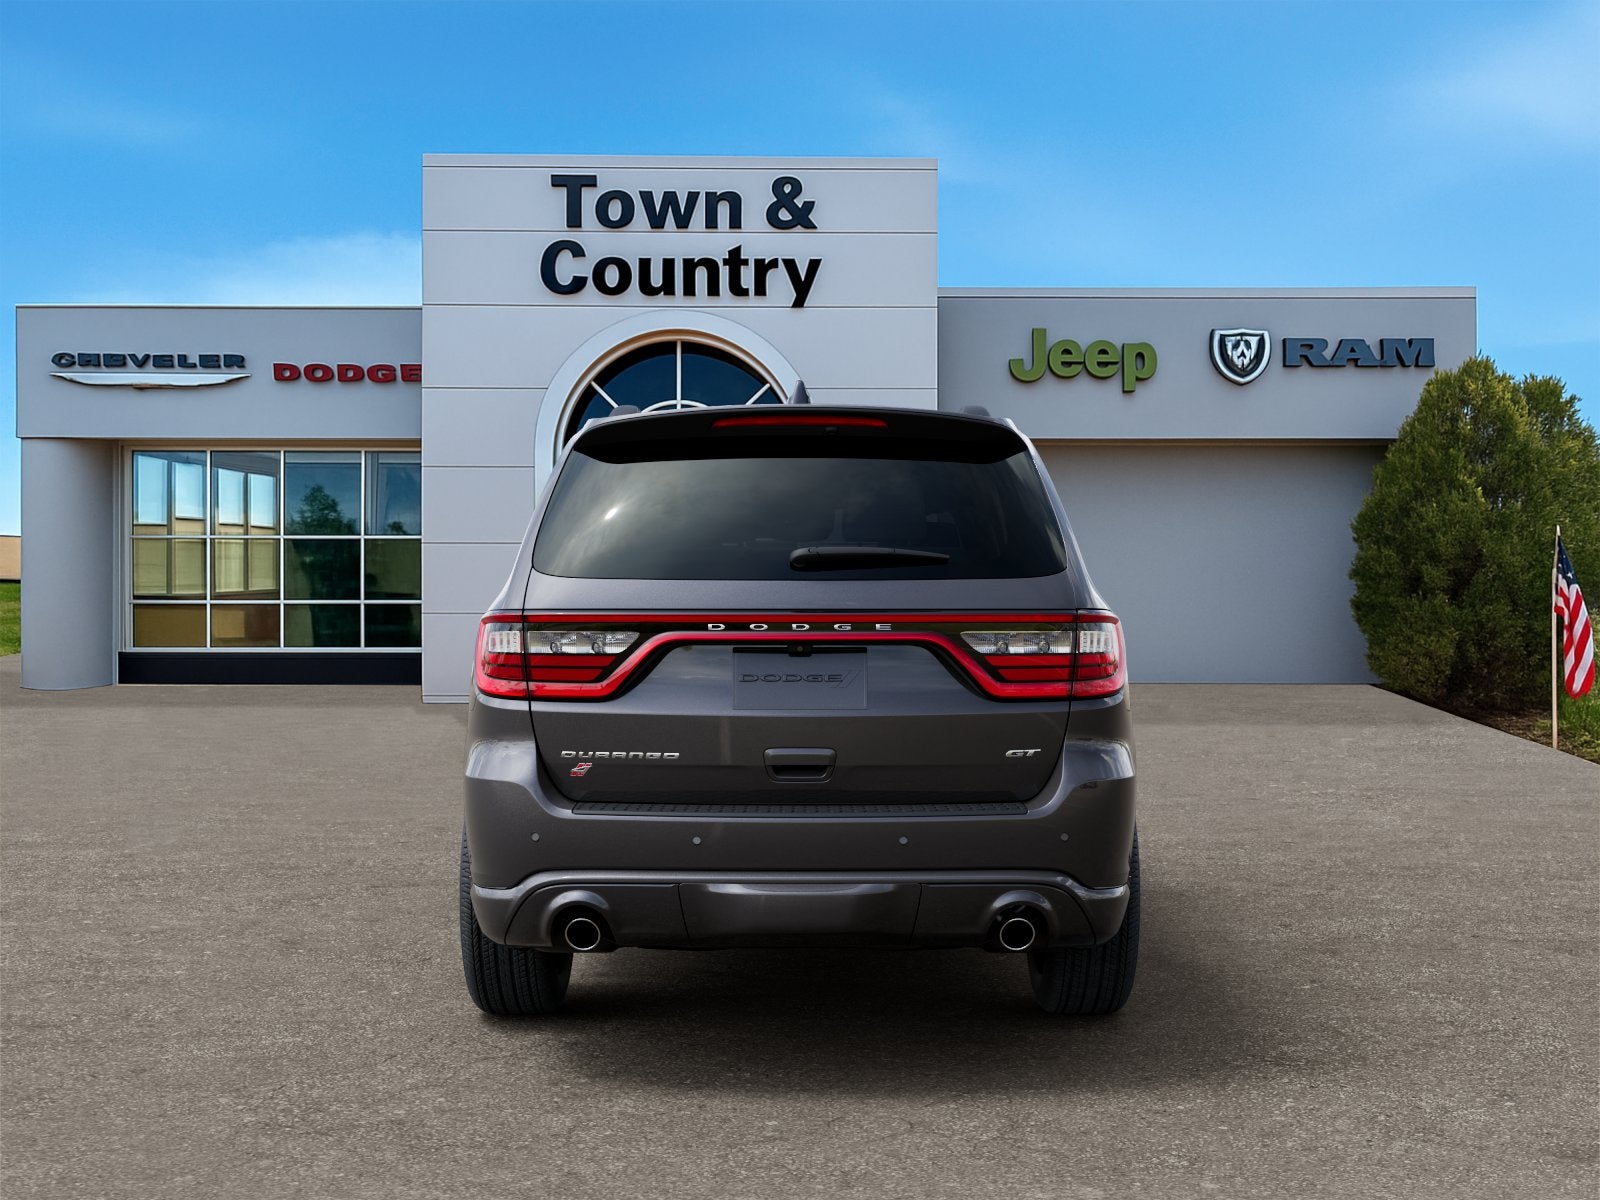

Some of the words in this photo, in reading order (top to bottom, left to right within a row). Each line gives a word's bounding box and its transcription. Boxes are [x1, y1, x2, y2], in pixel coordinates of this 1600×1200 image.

[550, 174, 742, 230] Town
[766, 176, 818, 230] &
[540, 239, 822, 308] Country
[1008, 327, 1158, 393] Jeep
[1282, 337, 1436, 368] RAM
[273, 363, 422, 383] DODGE
[707, 623, 893, 631] DODGE
[738, 673, 844, 683] DODGE
[560, 750, 680, 760] DURANGO
[1005, 748, 1042, 758] GT
